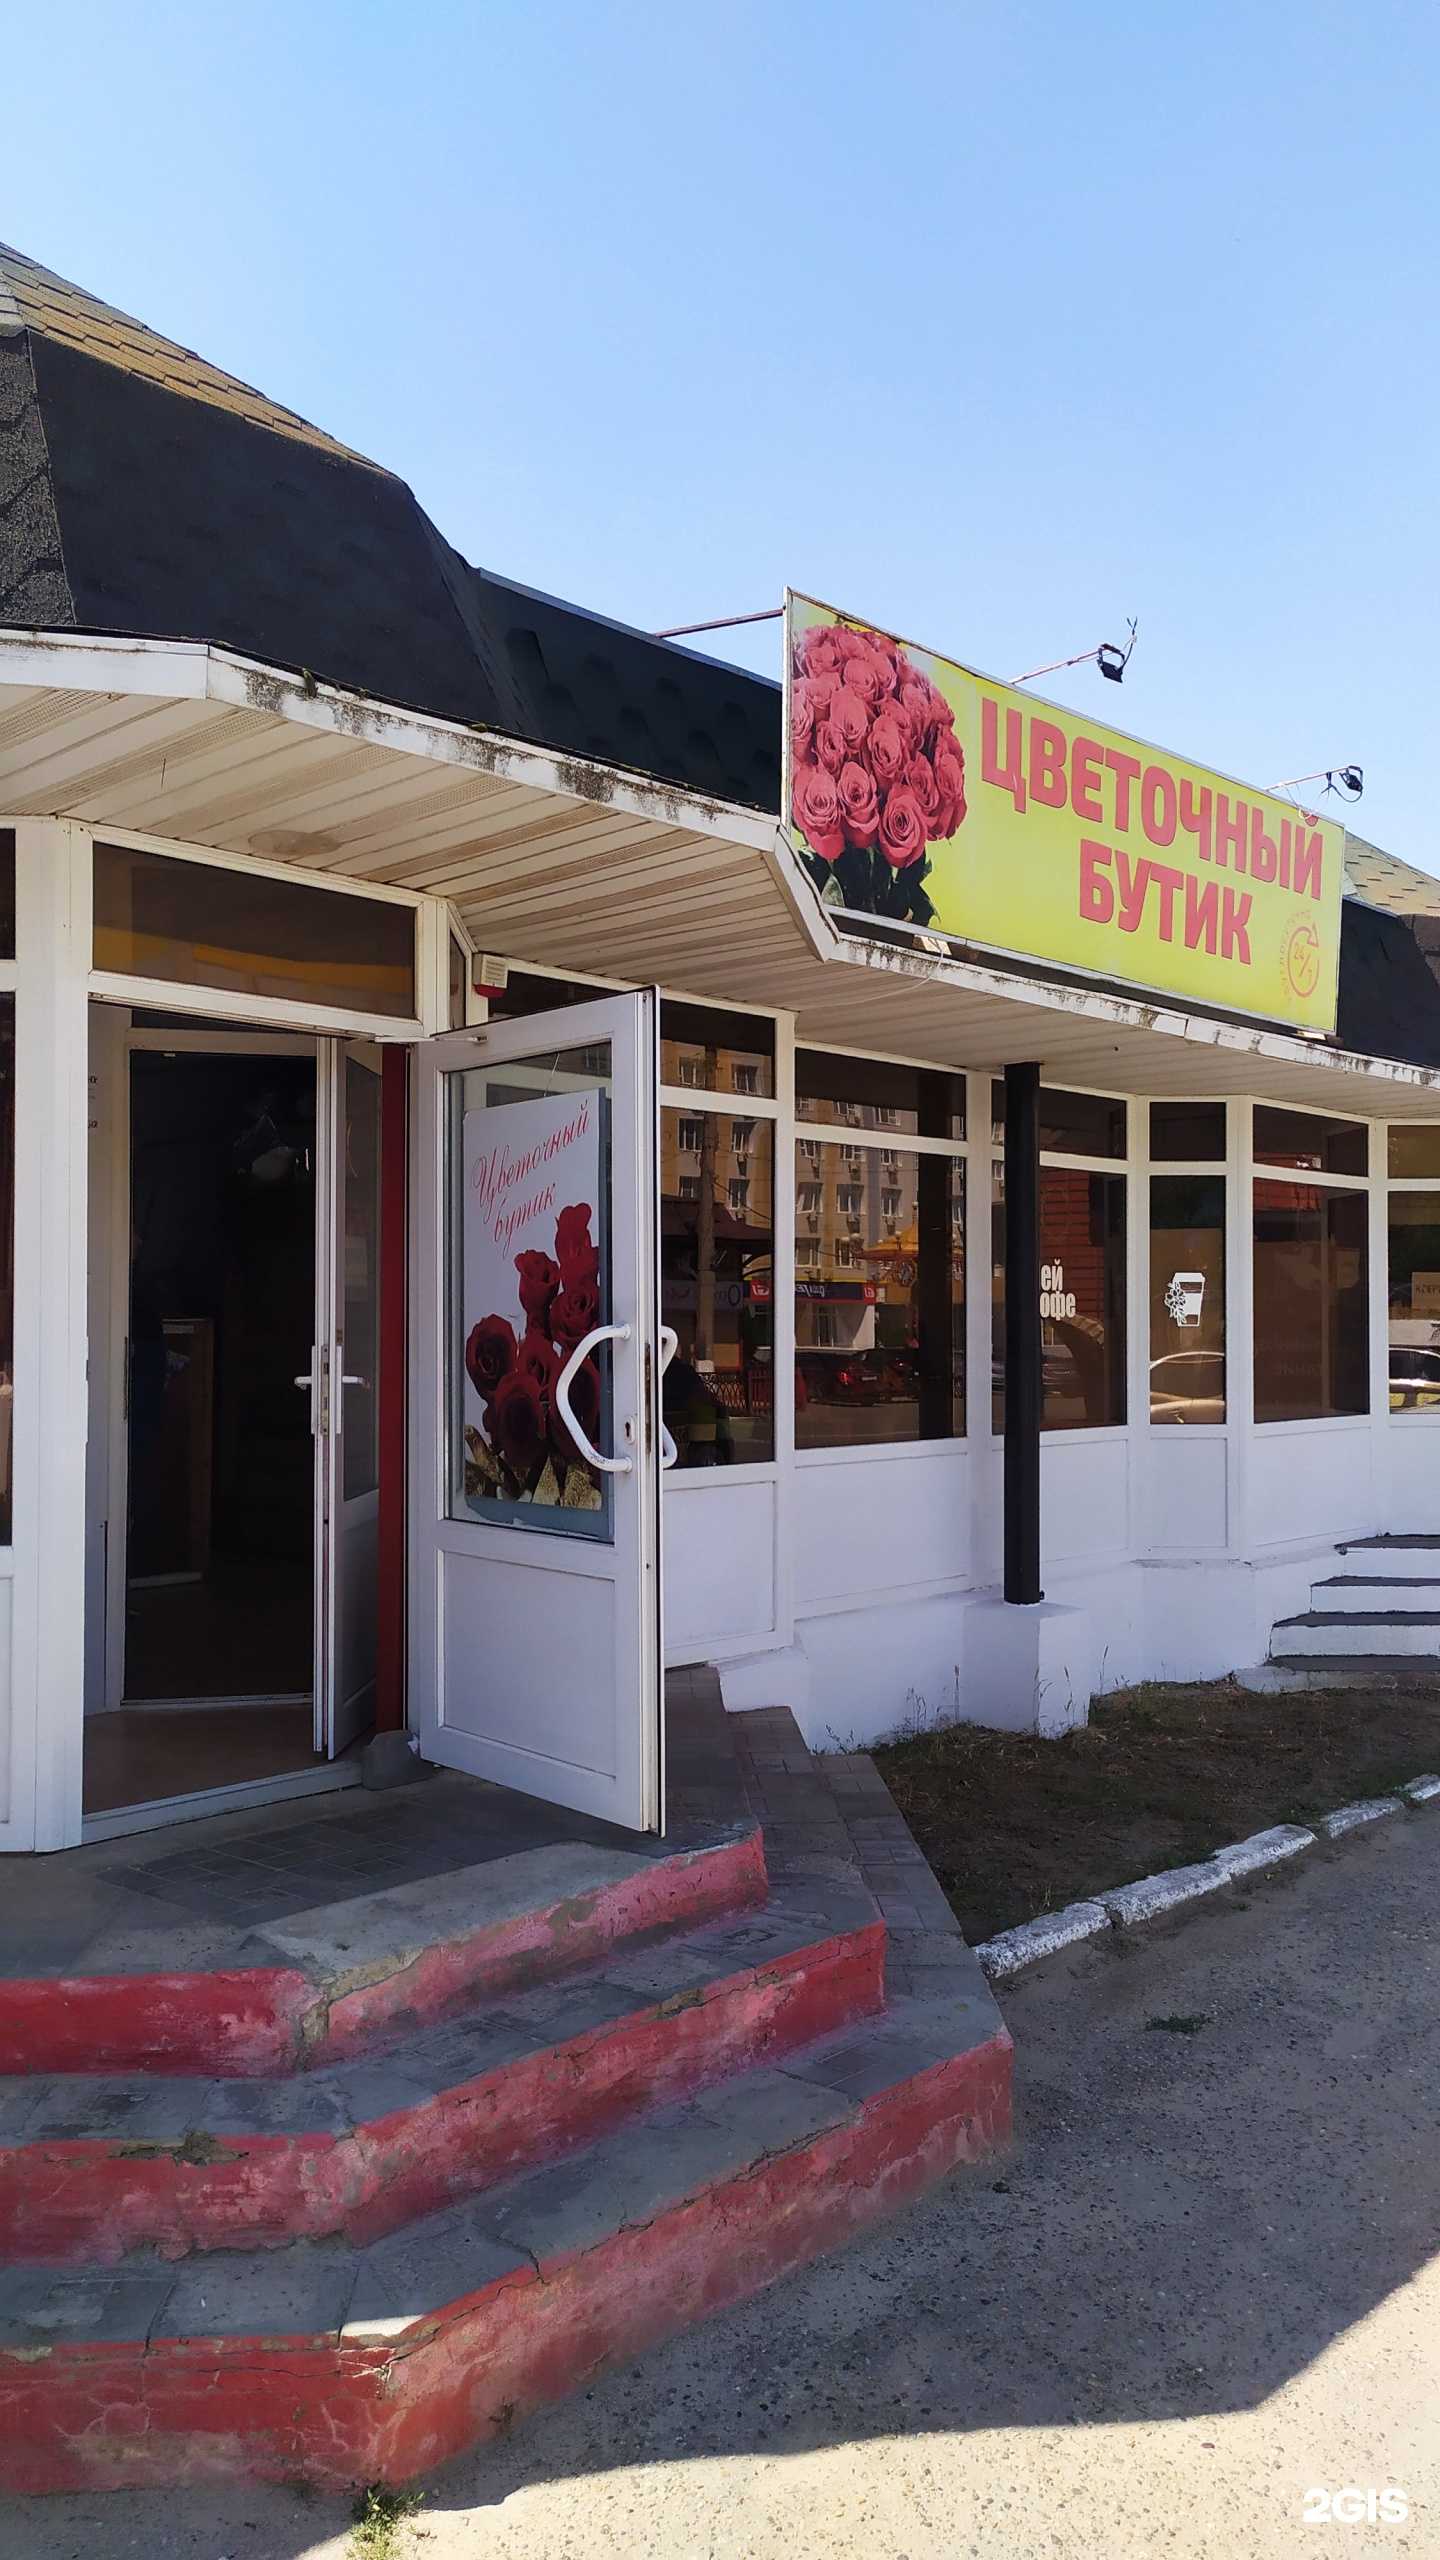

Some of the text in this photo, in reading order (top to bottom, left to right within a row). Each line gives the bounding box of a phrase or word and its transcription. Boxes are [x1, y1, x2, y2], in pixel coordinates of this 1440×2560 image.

[981, 696, 1323, 901] ЦВЕТОЧНЫЙ
[1079, 838, 1252, 965] БУТИК
[472, 1098, 589, 1224] Цветочный
[494, 1183, 556, 1260] бутик
[1040, 1258, 1063, 1291] ей
[1040, 1291, 1076, 1321] офе
